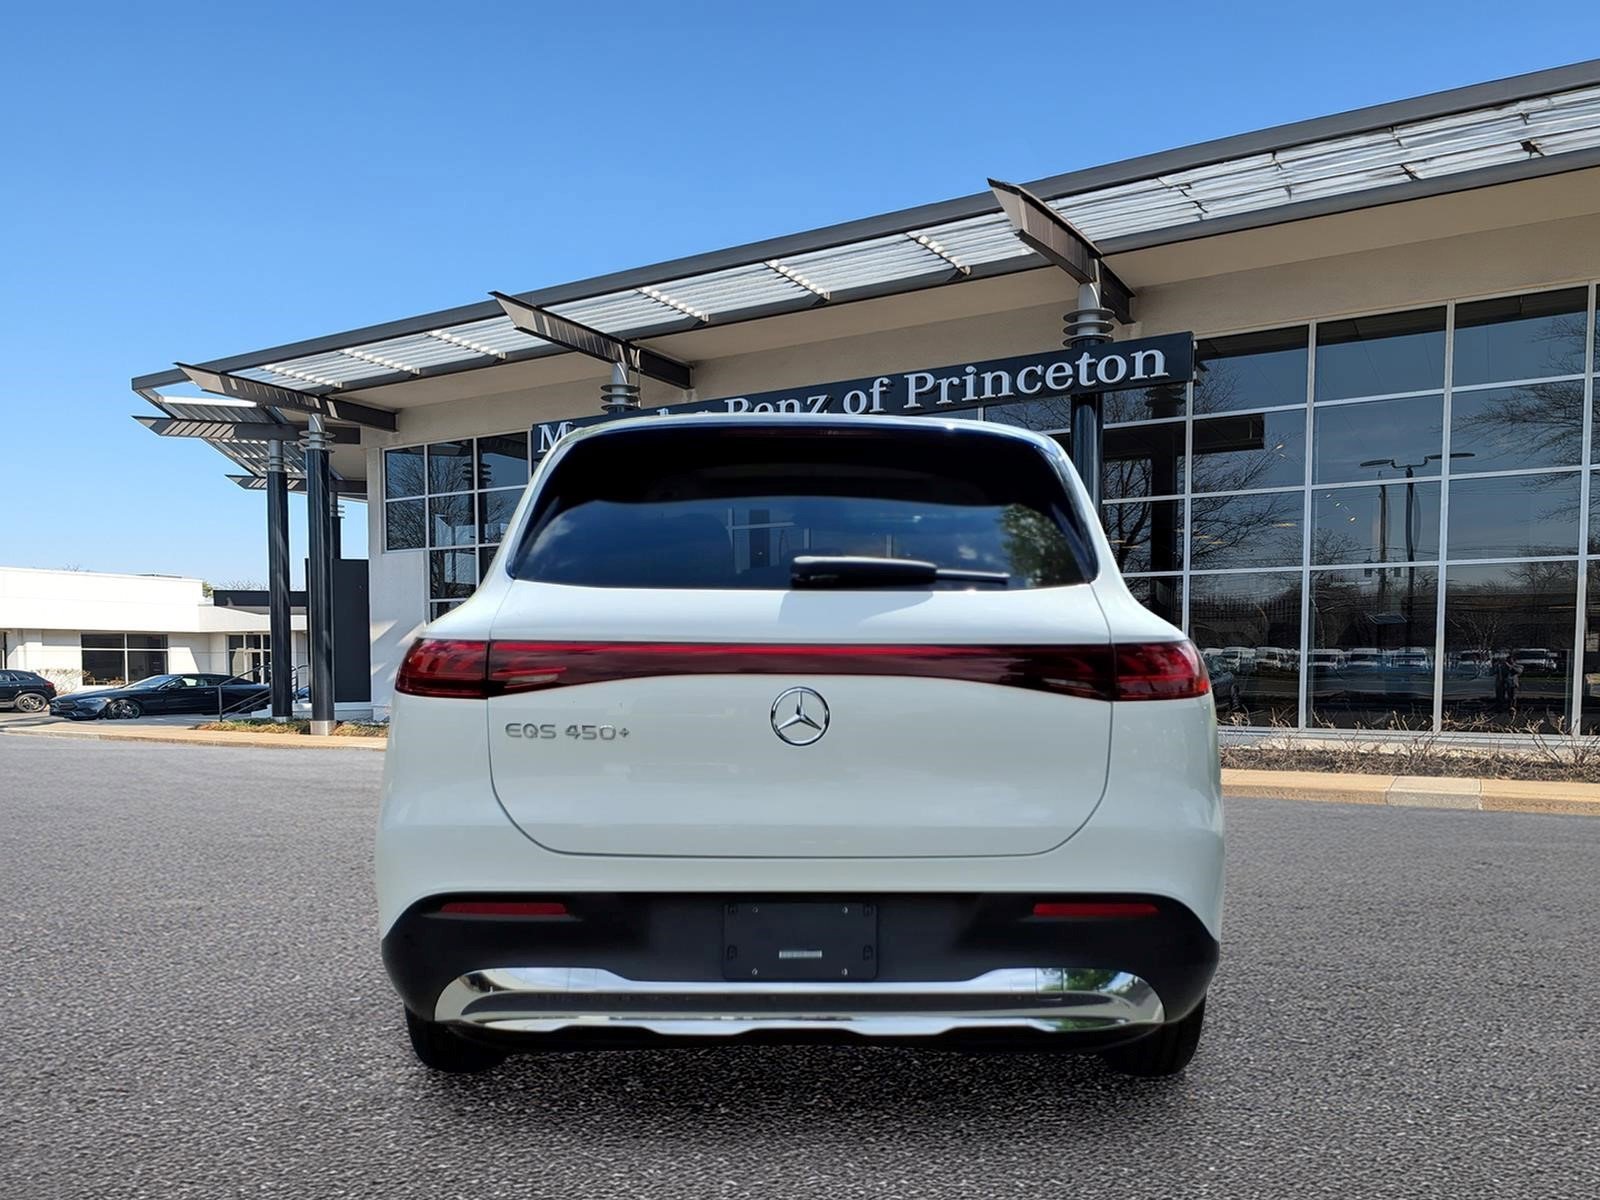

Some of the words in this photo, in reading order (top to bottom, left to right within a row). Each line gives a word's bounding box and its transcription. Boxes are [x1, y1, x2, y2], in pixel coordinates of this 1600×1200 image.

[843, 377, 891, 415] of
[903, 348, 1169, 409] Princeton
[505, 722, 557, 739] EQS
[565, 725, 630, 741] 450+
